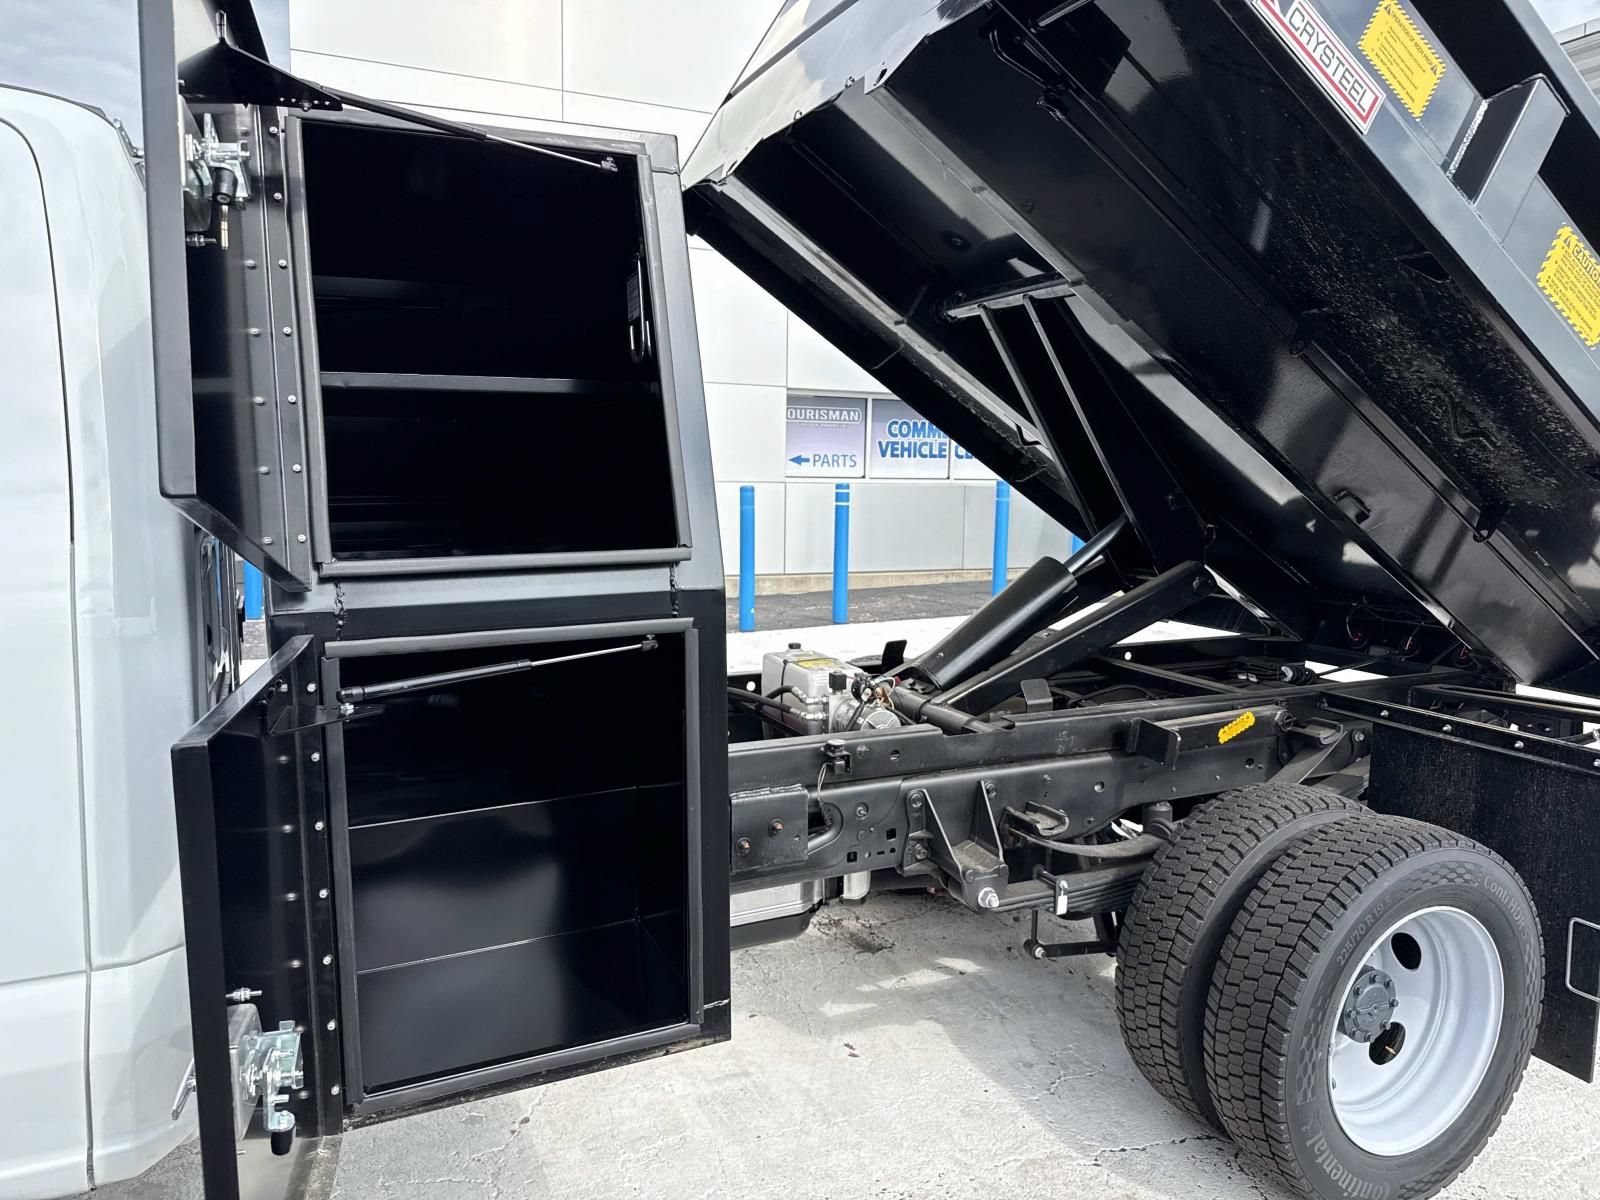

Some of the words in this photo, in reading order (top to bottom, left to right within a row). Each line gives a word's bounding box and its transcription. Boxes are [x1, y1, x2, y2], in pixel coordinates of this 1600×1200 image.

[1288, 6, 1366, 112] CRYSTEEL
[1573, 245, 1600, 284] CAUTIO
[787, 408, 859, 422] OURISMAN
[813, 454, 857, 468] PARTS
[878, 440, 947, 458] VEHICLE
[1484, 874, 1510, 904] Conti
[1336, 924, 1366, 966] 225/70
[1364, 914, 1374, 926] R
